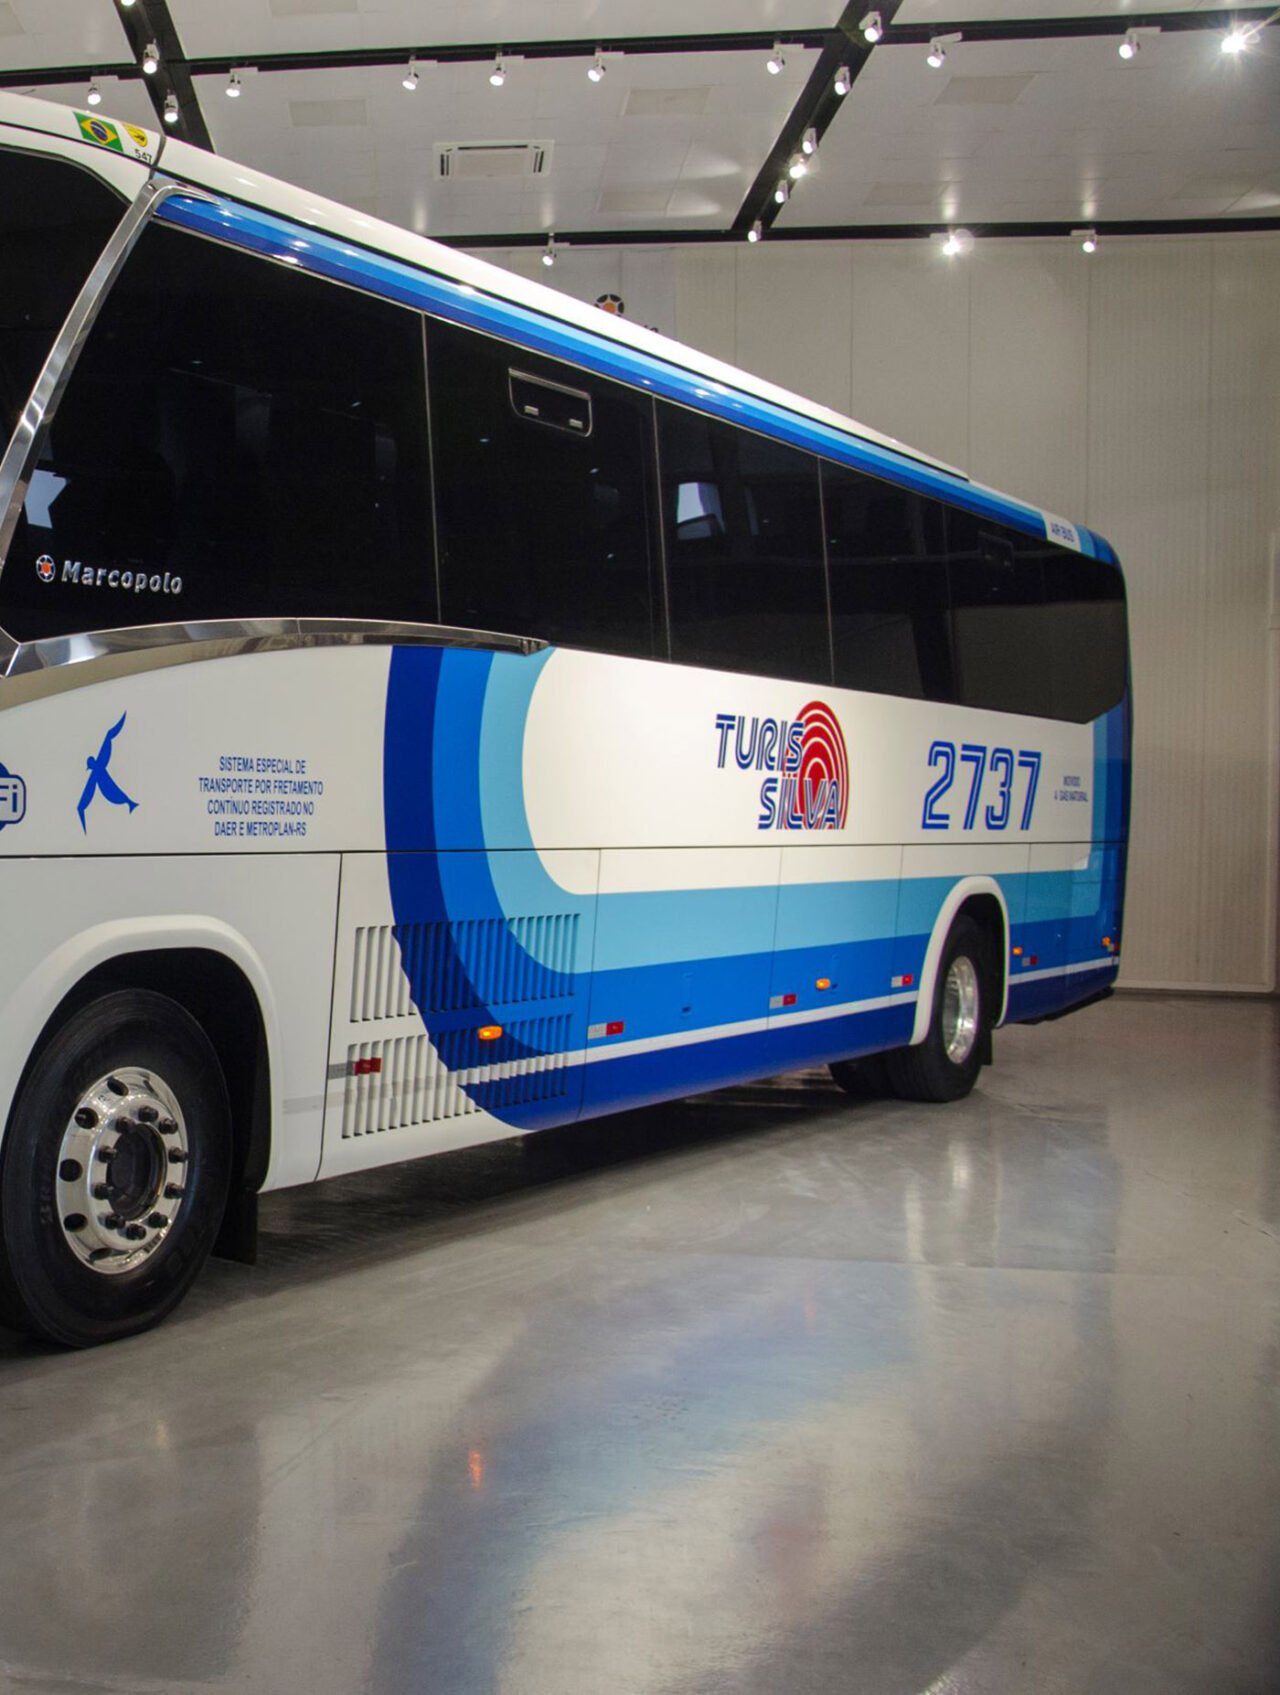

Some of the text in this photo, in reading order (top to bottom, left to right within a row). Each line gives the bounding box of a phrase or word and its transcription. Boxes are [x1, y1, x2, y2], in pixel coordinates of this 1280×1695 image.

[61, 560, 183, 594] Marcopolo
[715, 714, 804, 772] TURIS
[220, 756, 306, 774] SISTEMA ESPECIAL DE
[199, 777, 324, 795] TRANSPORTE POR FRETAMENTO
[921, 740, 1042, 831] 2737
[251, 800, 301, 815] REGISTRADO
[303, 801, 314, 815] NO
[758, 777, 840, 830] SILVA
[215, 821, 307, 836] DAER E METROPLAN-RS
